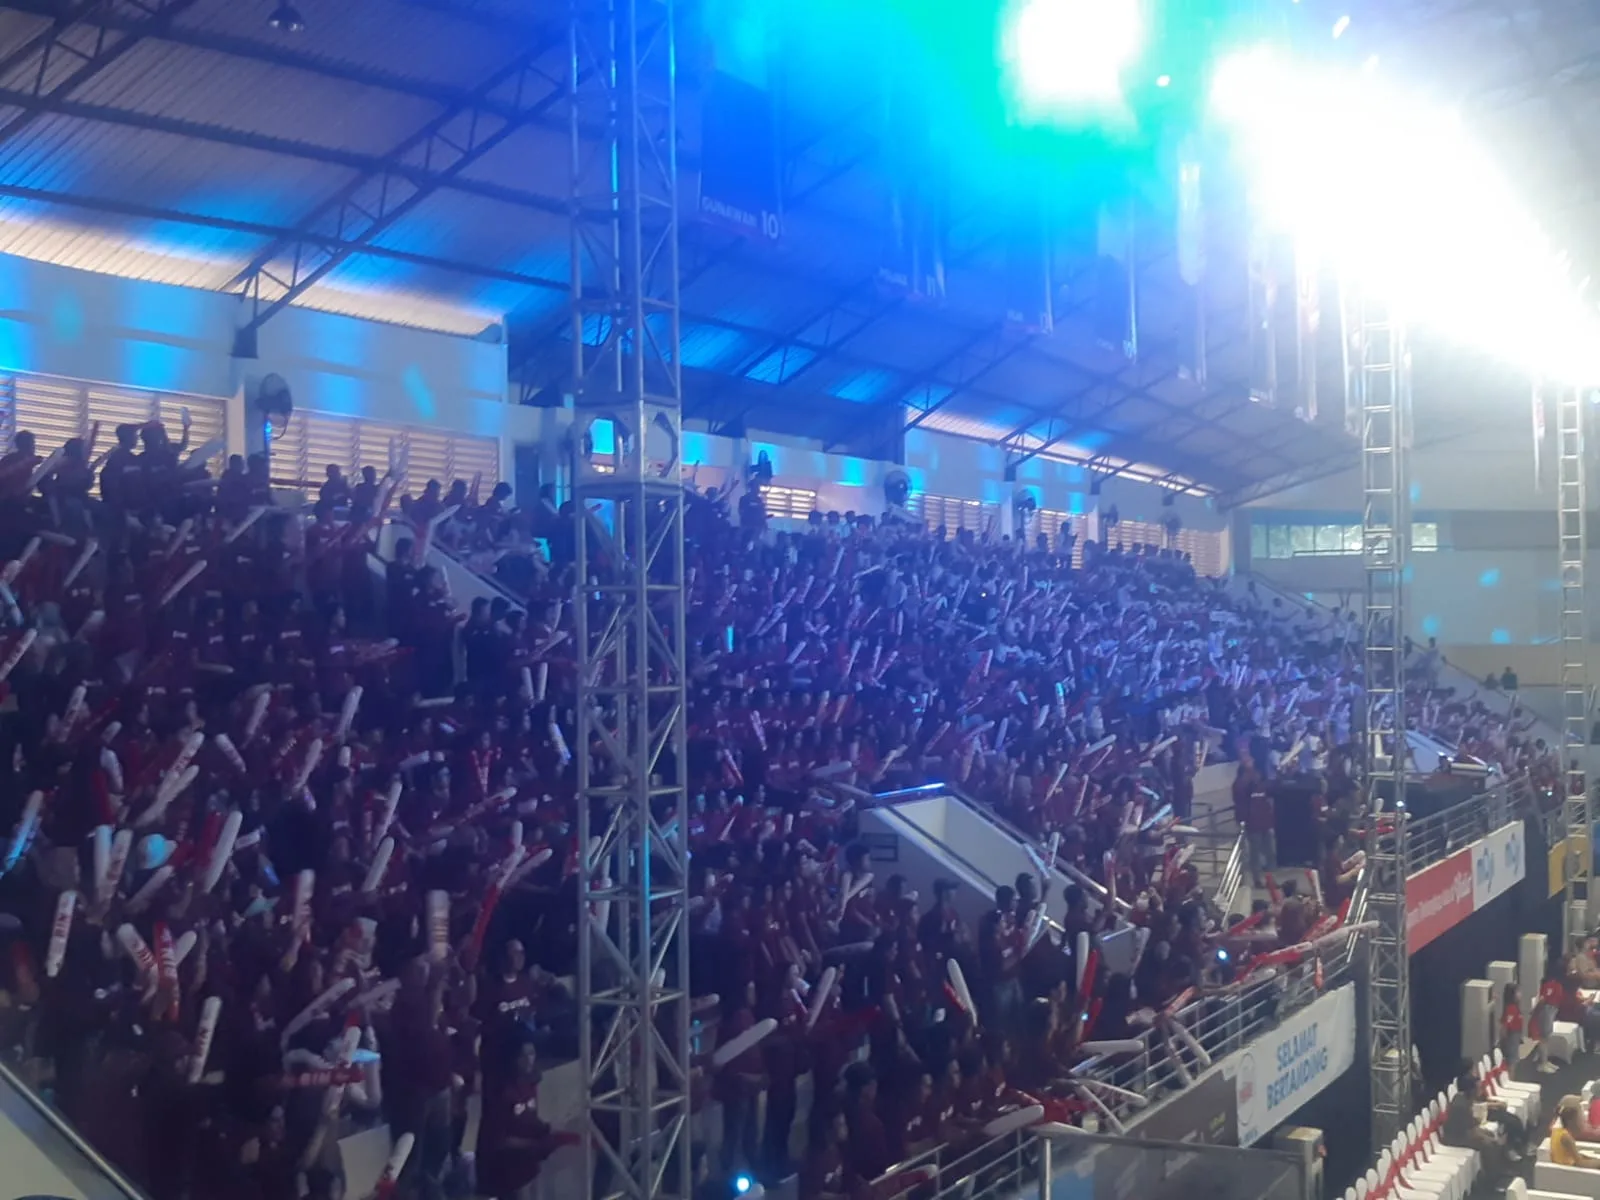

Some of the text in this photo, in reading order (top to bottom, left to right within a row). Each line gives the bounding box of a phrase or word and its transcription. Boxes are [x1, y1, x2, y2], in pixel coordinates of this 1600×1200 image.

[762, 210, 779, 240] 10
[1277, 1022, 1318, 1072] SELAMAT
[1266, 1046, 1328, 1110] BERTANDING
